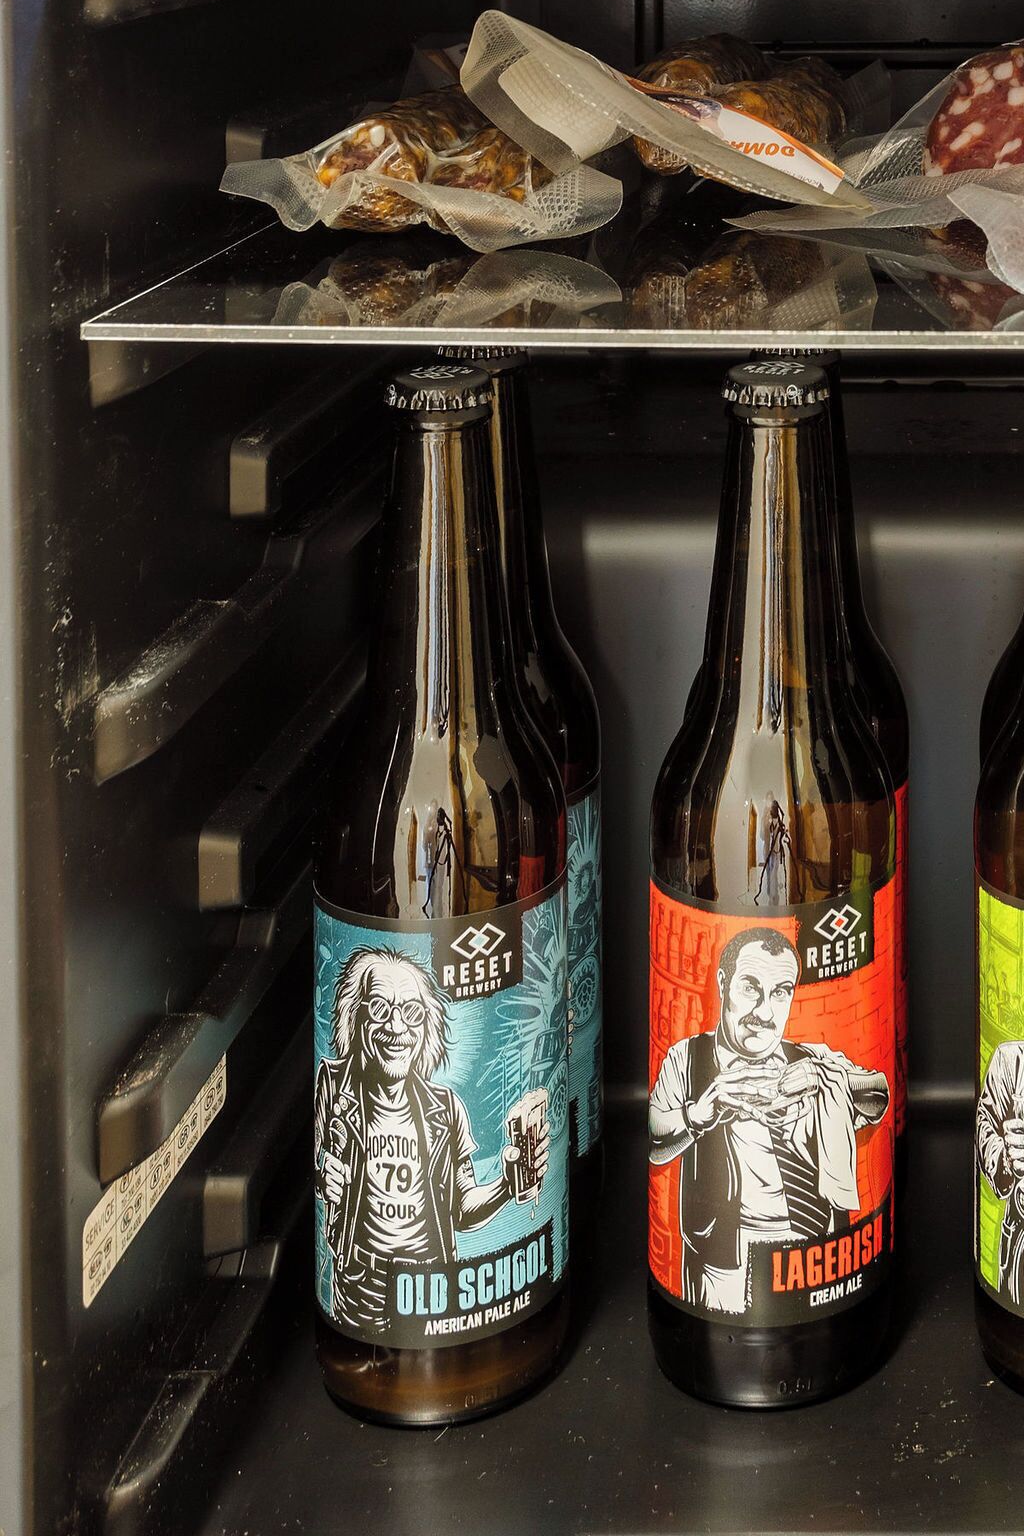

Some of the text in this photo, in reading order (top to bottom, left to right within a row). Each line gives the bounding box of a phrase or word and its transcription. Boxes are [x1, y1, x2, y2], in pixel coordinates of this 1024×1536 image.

[443, 950, 513, 987] RESET
[806, 931, 867, 969] RESET
[818, 958, 858, 979] BREWERY
[455, 978, 502, 998] BREWERY
[85, 1198, 115, 1253] SERVICE
[377, 1201, 417, 1220] TOUR
[772, 1212, 883, 1292] LAGERISH
[396, 1234, 549, 1315] OLD SCHOOL
[809, 1273, 863, 1307] CREAM ALE
[424, 1290, 531, 1336] AMERICAN PALE ALE
